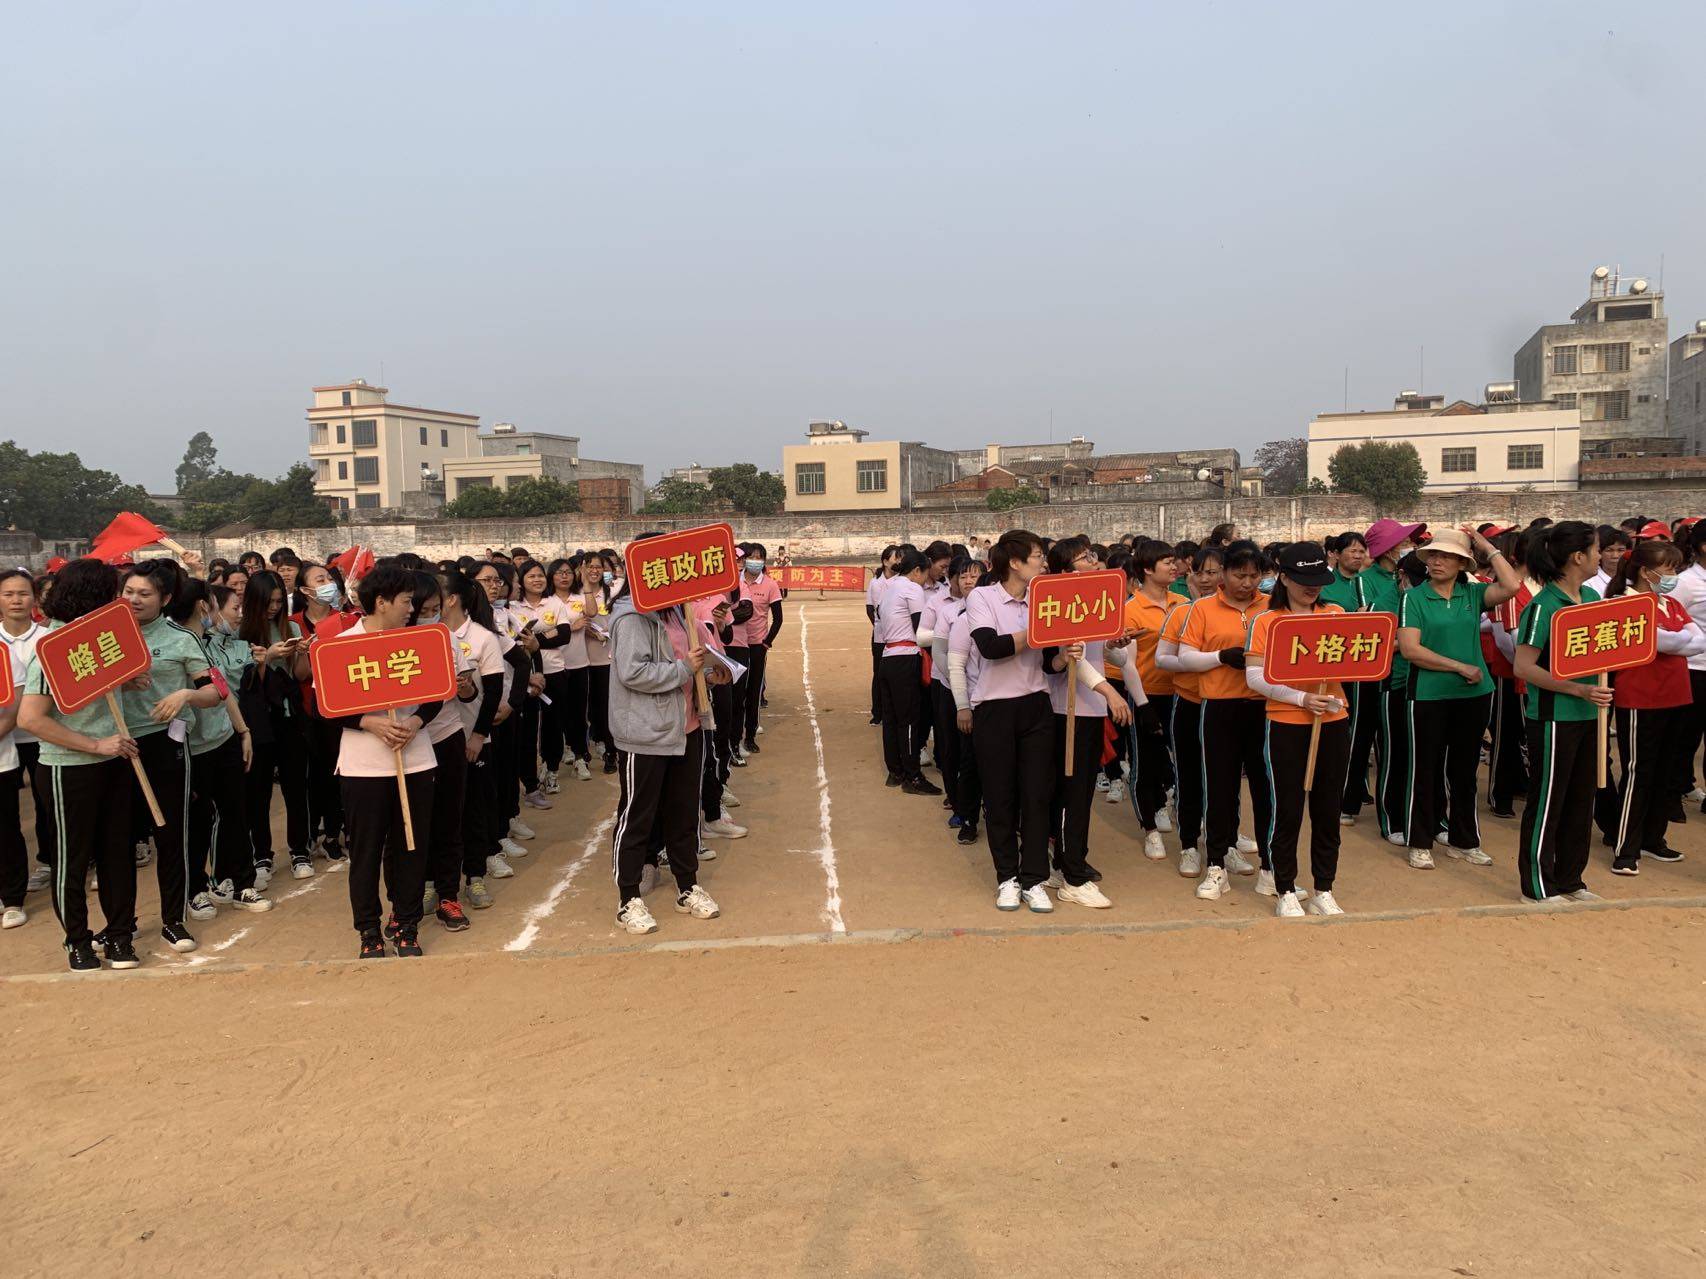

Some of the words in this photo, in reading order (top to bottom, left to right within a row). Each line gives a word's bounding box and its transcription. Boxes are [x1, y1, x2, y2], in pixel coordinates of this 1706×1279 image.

[641, 545, 725, 590] 镇政府
[1038, 590, 1116, 628] 中心小
[67, 631, 126, 682] 蜂皇
[1290, 632, 1382, 665] 卜格村
[1564, 614, 1647, 657] 居蕉村
[347, 649, 422, 691] 中学
